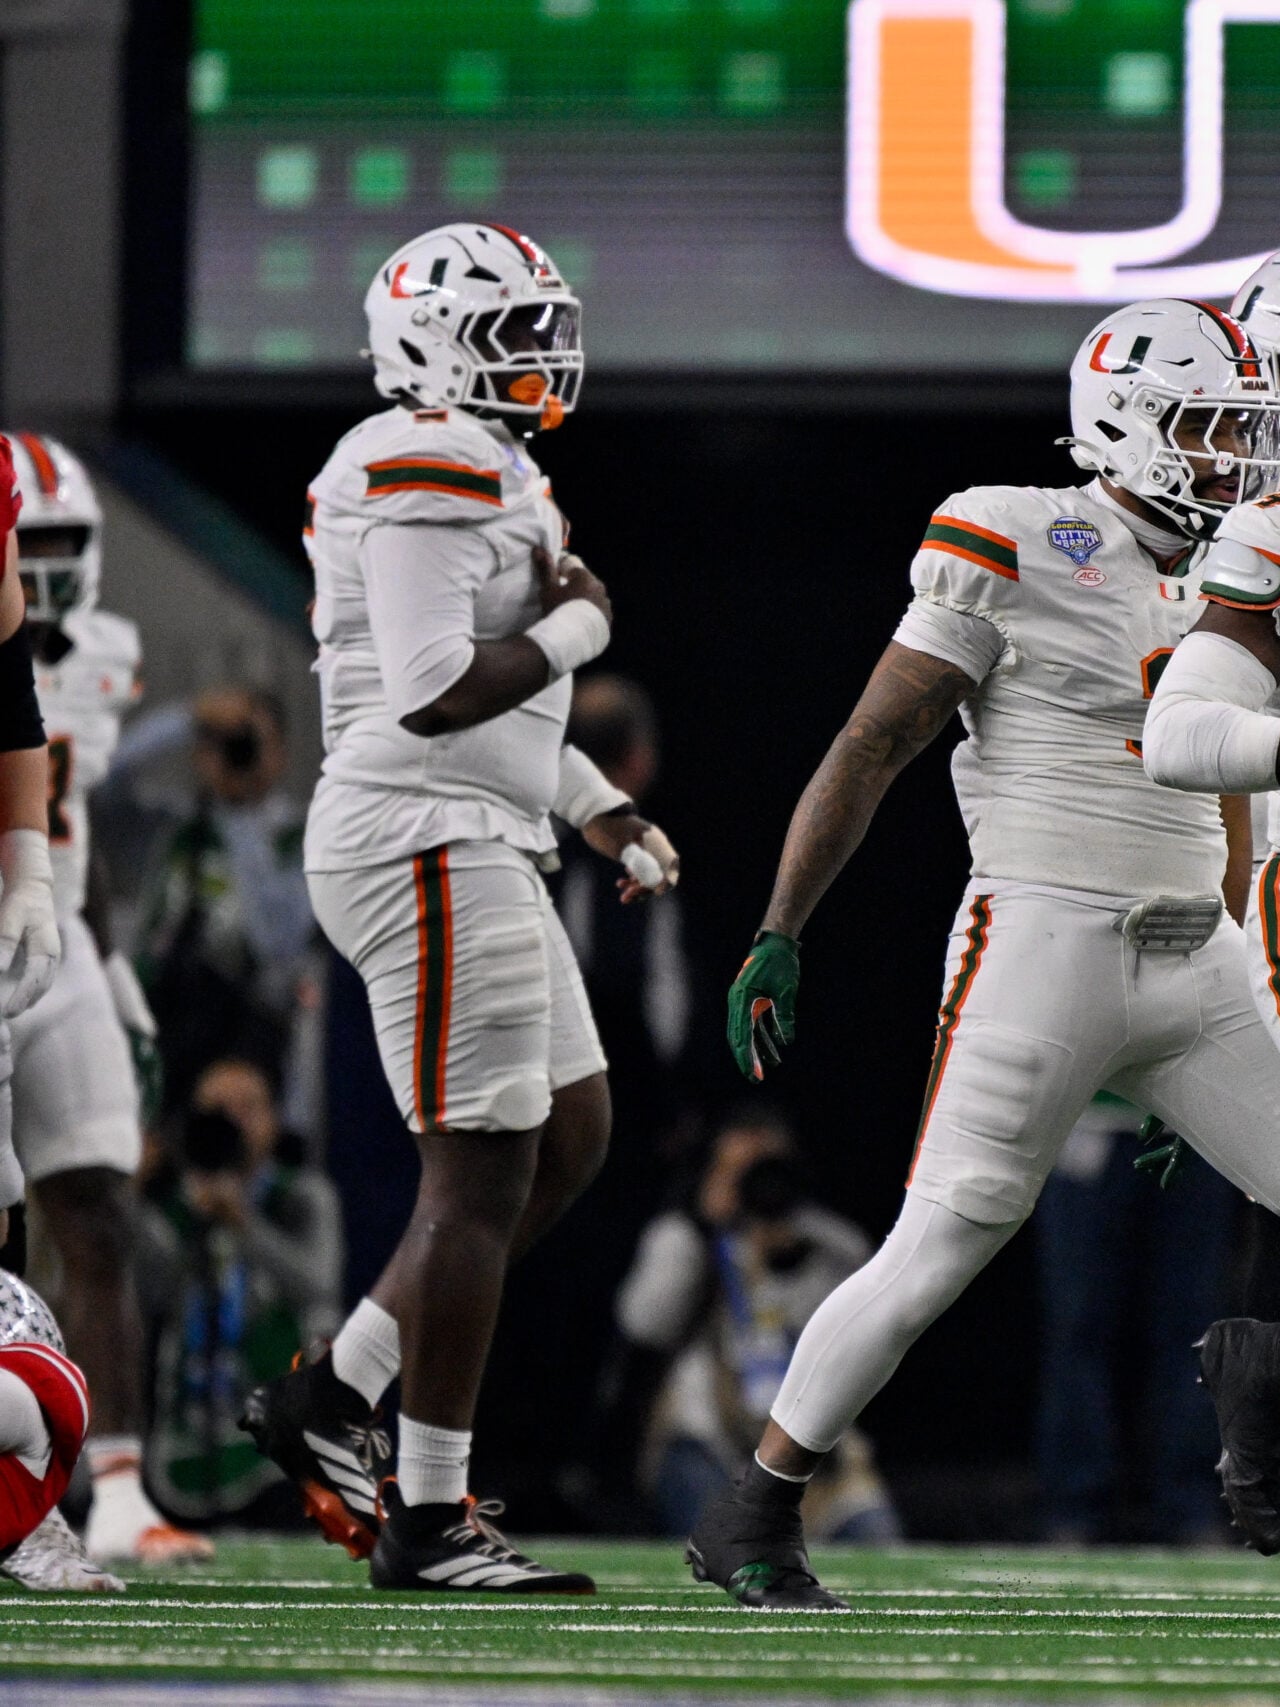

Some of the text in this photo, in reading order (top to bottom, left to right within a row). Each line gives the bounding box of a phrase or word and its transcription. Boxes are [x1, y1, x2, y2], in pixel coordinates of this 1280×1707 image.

[1089, 333, 1153, 374] U
[1241, 380, 1270, 391] MIAMI
[1051, 530, 1099, 546] COTTON
[1062, 538, 1093, 549] BOWL
[1077, 571, 1102, 580] ACC
[1159, 582, 1186, 601] U
